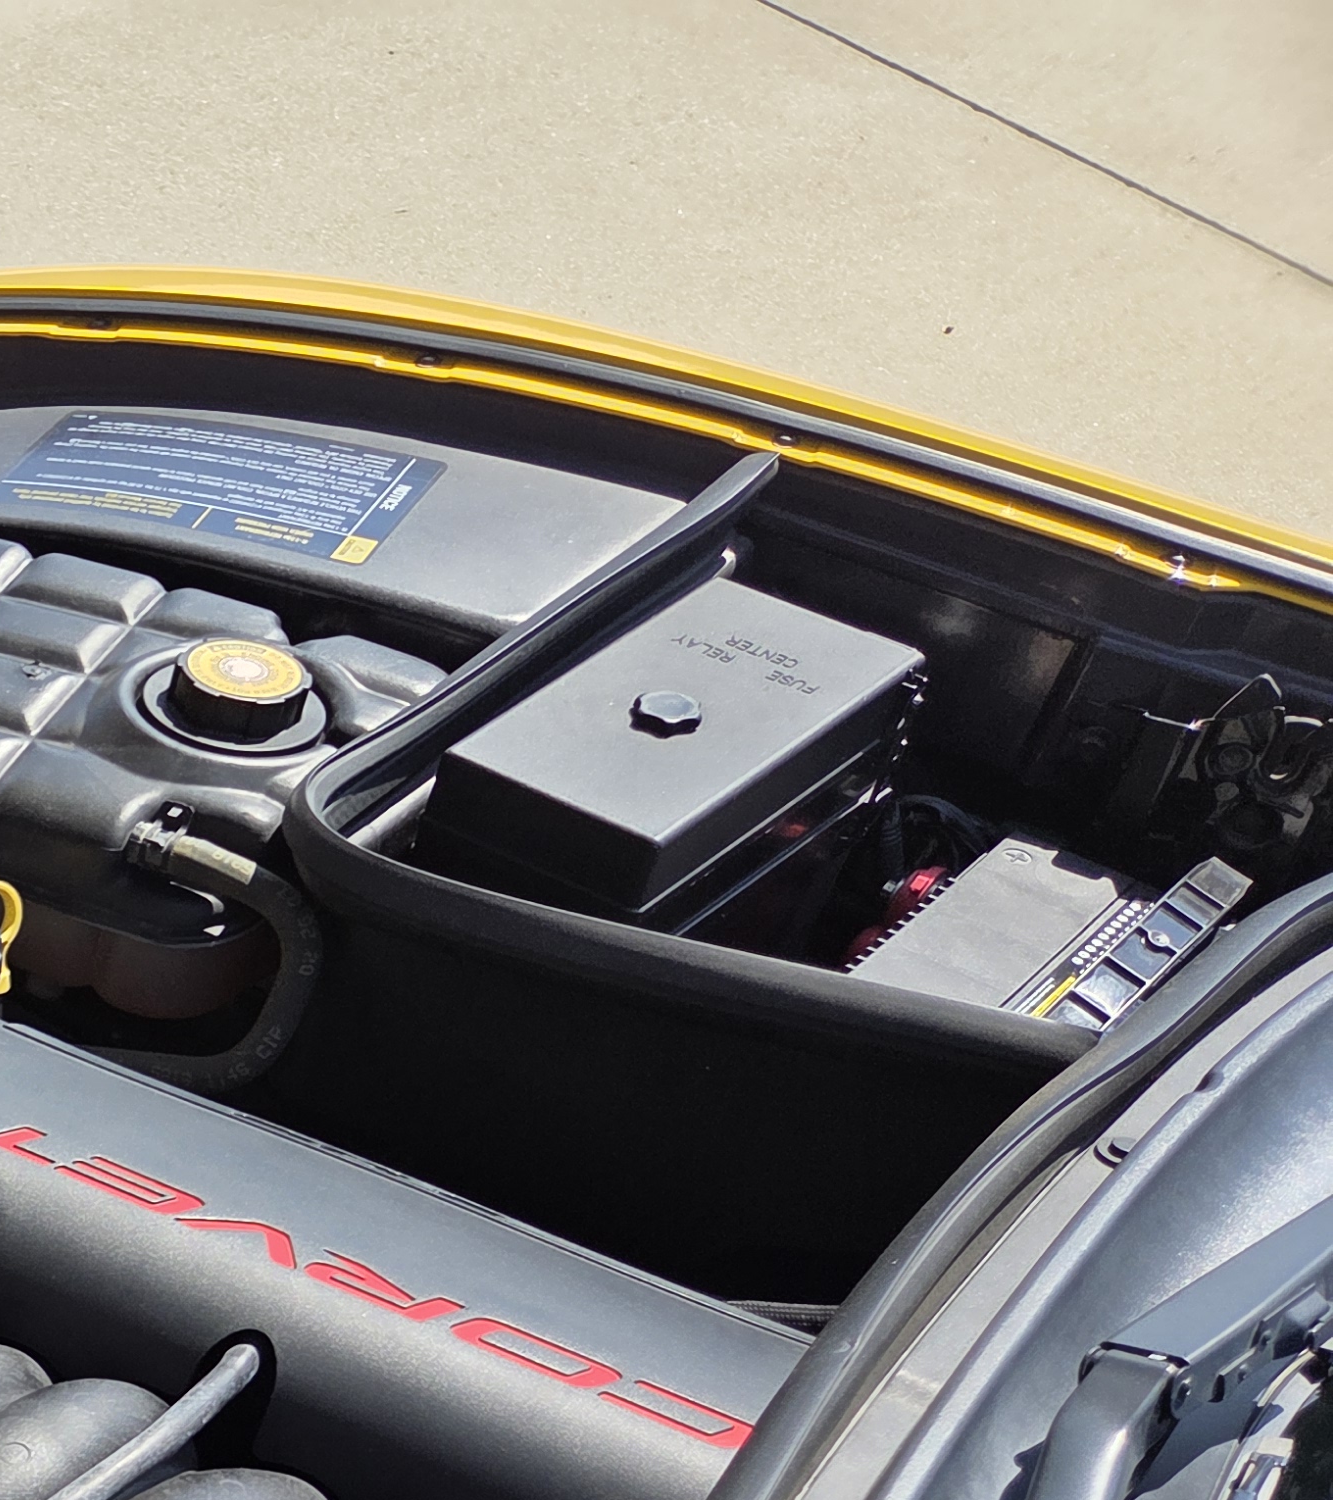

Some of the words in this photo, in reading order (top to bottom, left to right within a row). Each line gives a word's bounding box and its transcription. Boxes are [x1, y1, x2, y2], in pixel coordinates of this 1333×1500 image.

[376, 483, 413, 511] NOTICE
[670, 633, 737, 664] RELAY
[724, 634, 800, 670] CENTER
[765, 669, 821, 696] FUSE
